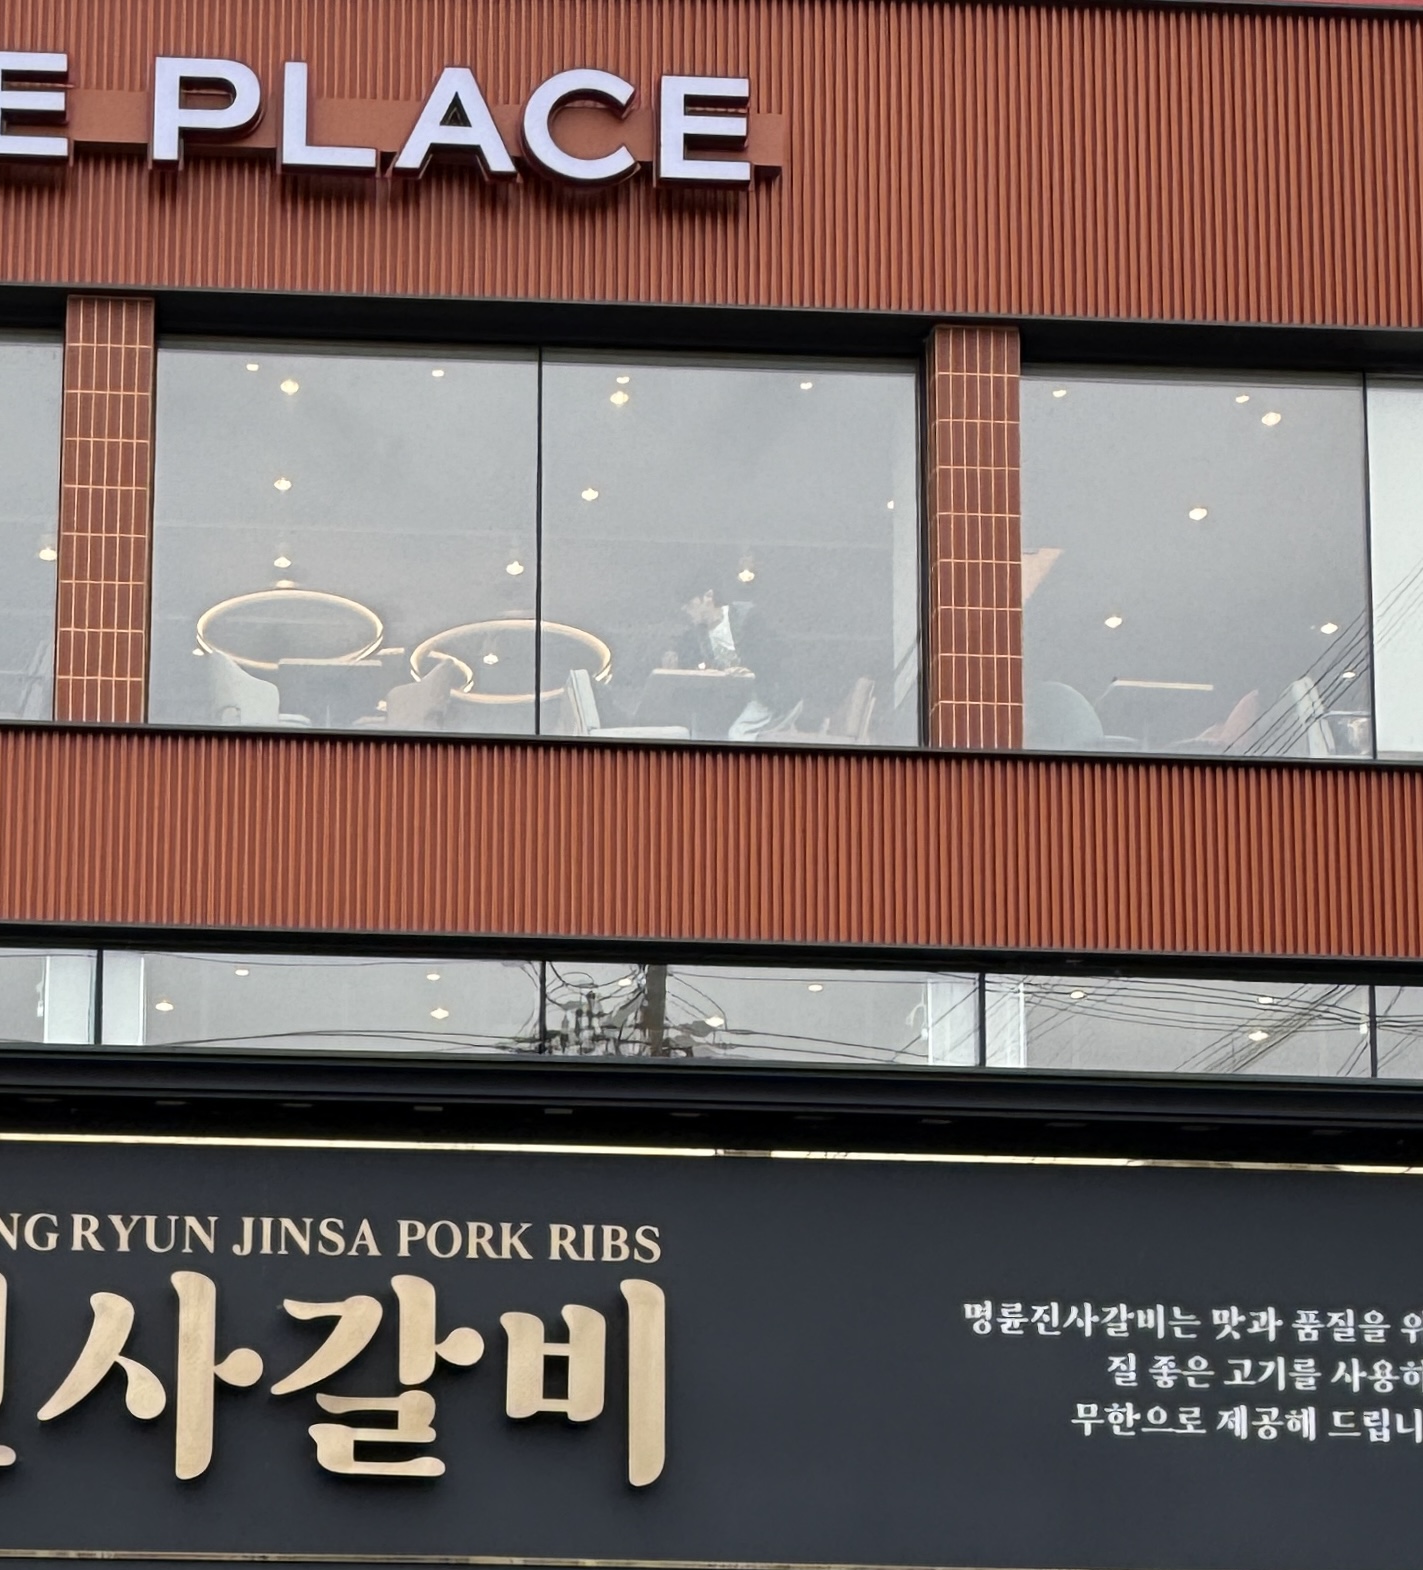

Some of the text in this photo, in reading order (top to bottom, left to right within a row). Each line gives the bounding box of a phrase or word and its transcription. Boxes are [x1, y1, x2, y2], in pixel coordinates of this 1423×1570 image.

[152, 55, 751, 184] PLACE
[232, 1215, 382, 1257] JINSA
[397, 1220, 533, 1262] PORK
[548, 1223, 662, 1264] RIBS
[964, 1300, 1201, 1339] 명륜진사갈비는
[1212, 1306, 1284, 1342] 맛과
[1291, 1309, 1391, 1343] 품질을
[1107, 1352, 1138, 1387] 질
[1149, 1354, 1215, 1389] 좋은
[1224, 1356, 1321, 1391] 고기를
[1072, 1403, 1207, 1436] 무한으로
[1217, 1406, 1317, 1441] 제공해
